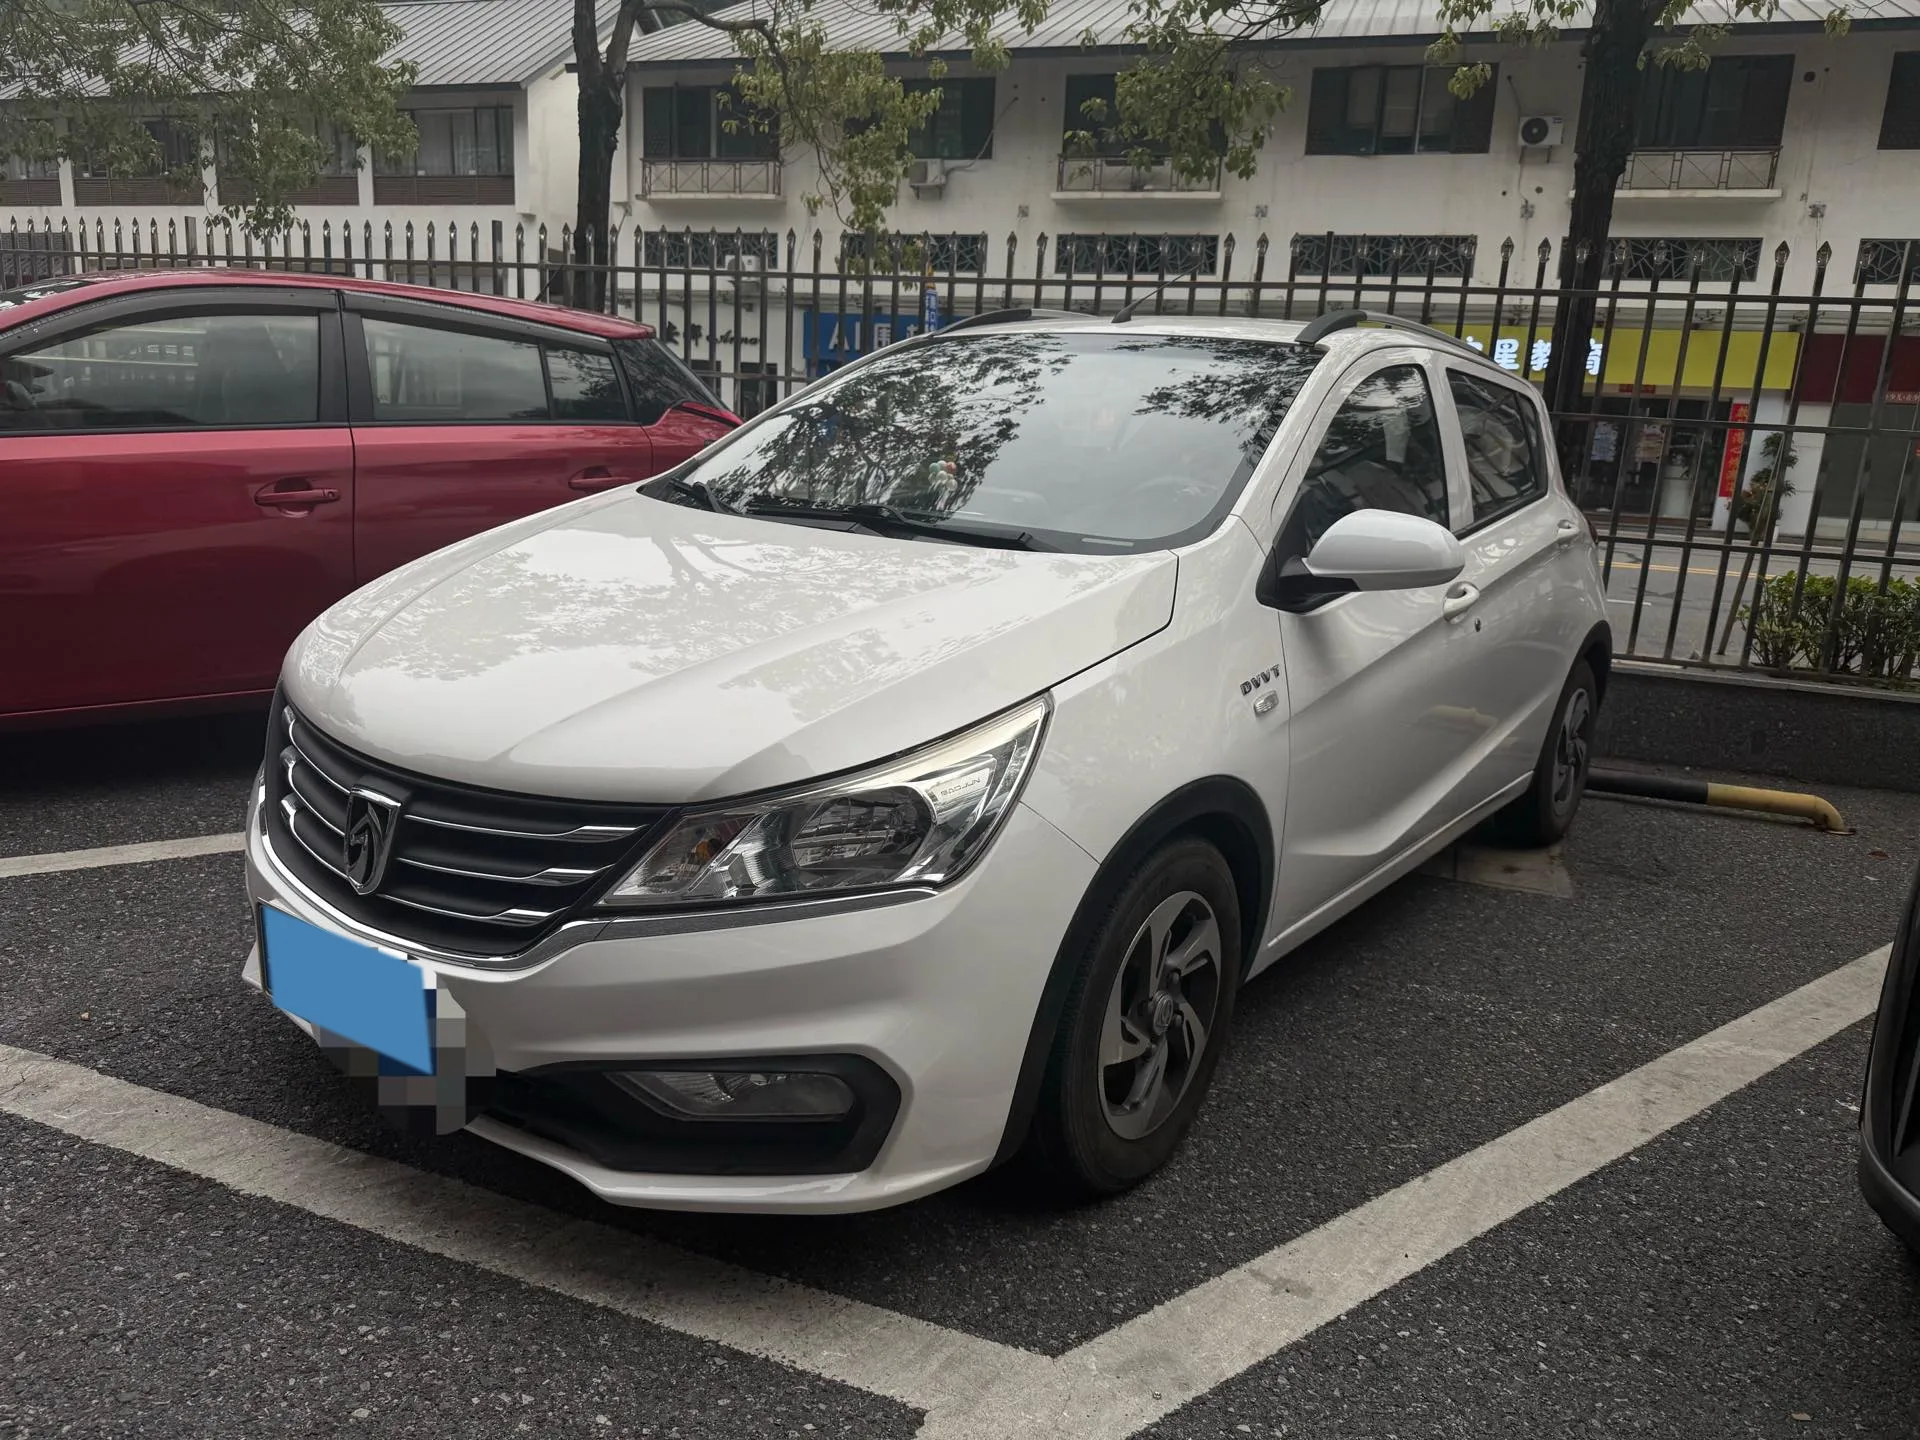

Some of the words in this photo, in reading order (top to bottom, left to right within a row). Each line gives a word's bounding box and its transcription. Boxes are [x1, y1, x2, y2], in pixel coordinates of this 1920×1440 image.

[1465, 335, 1604, 376] 星教育
[1240, 663, 1280, 696] DVVT
